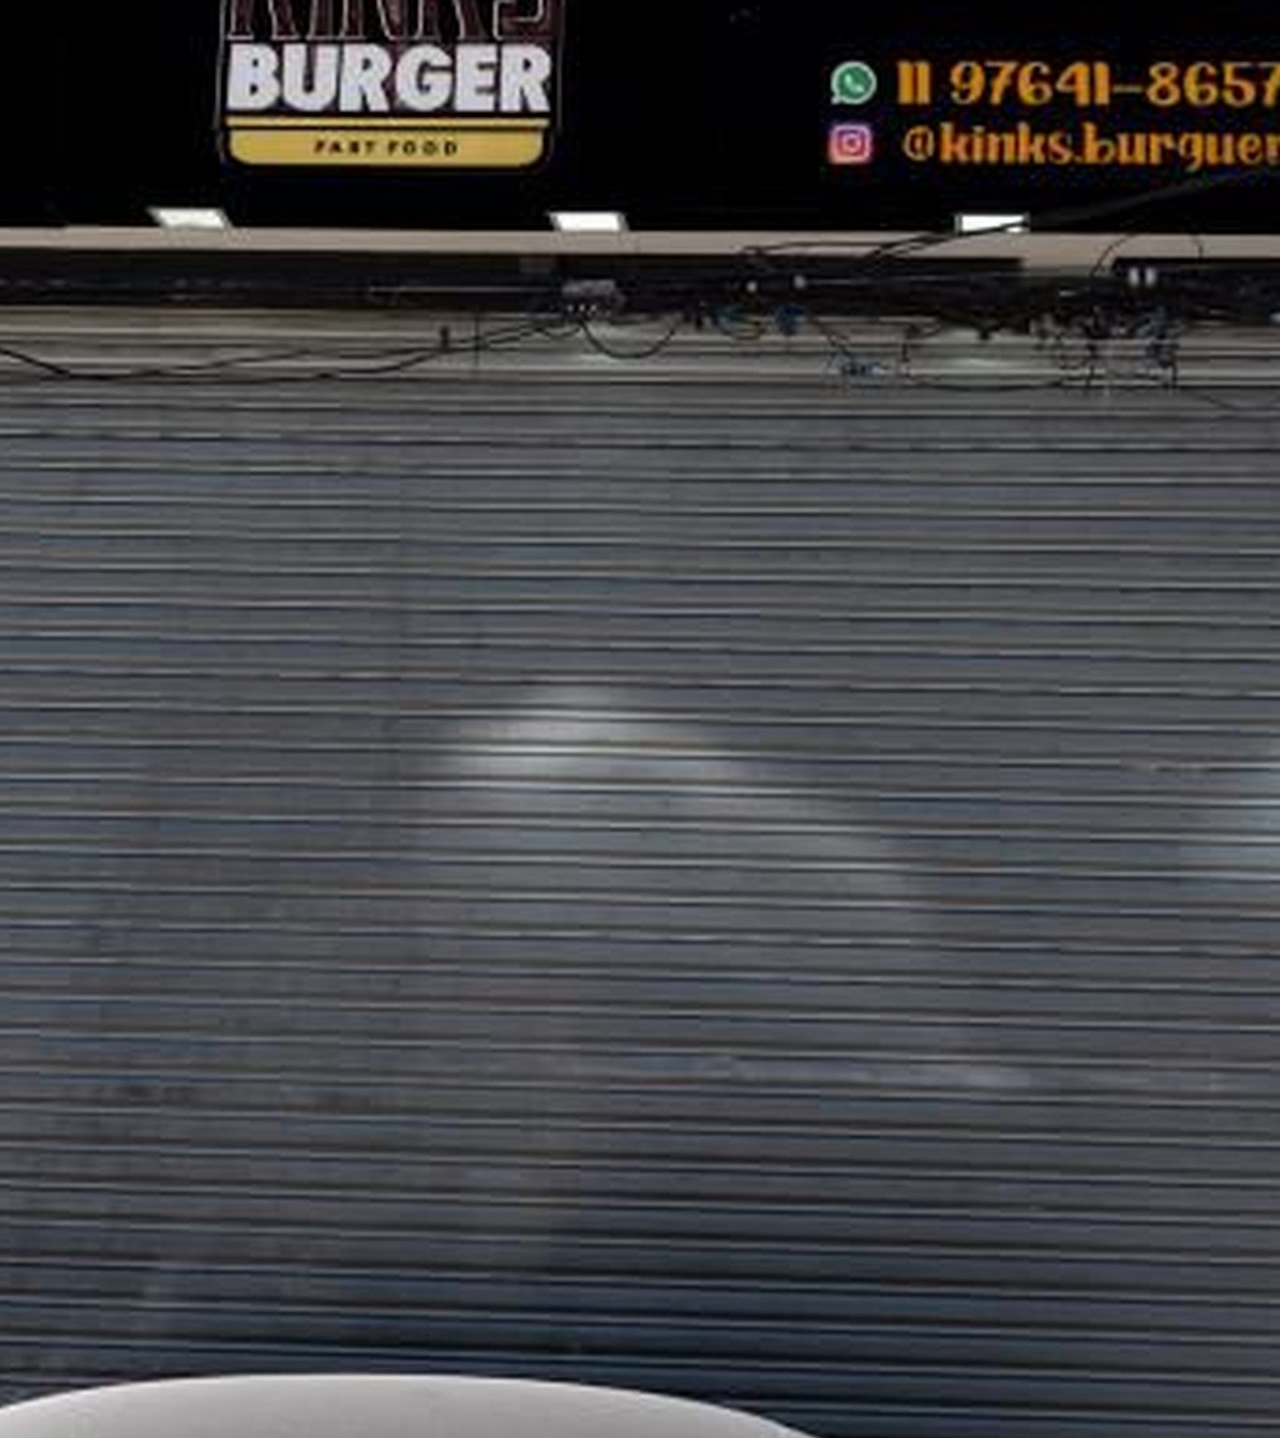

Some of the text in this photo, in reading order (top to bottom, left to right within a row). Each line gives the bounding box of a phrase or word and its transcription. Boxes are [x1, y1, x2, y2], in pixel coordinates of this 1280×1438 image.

[226, 42, 554, 113] BURGER
[896, 60, 932, 105] 11
[312, 139, 458, 156] FAST FOOD
